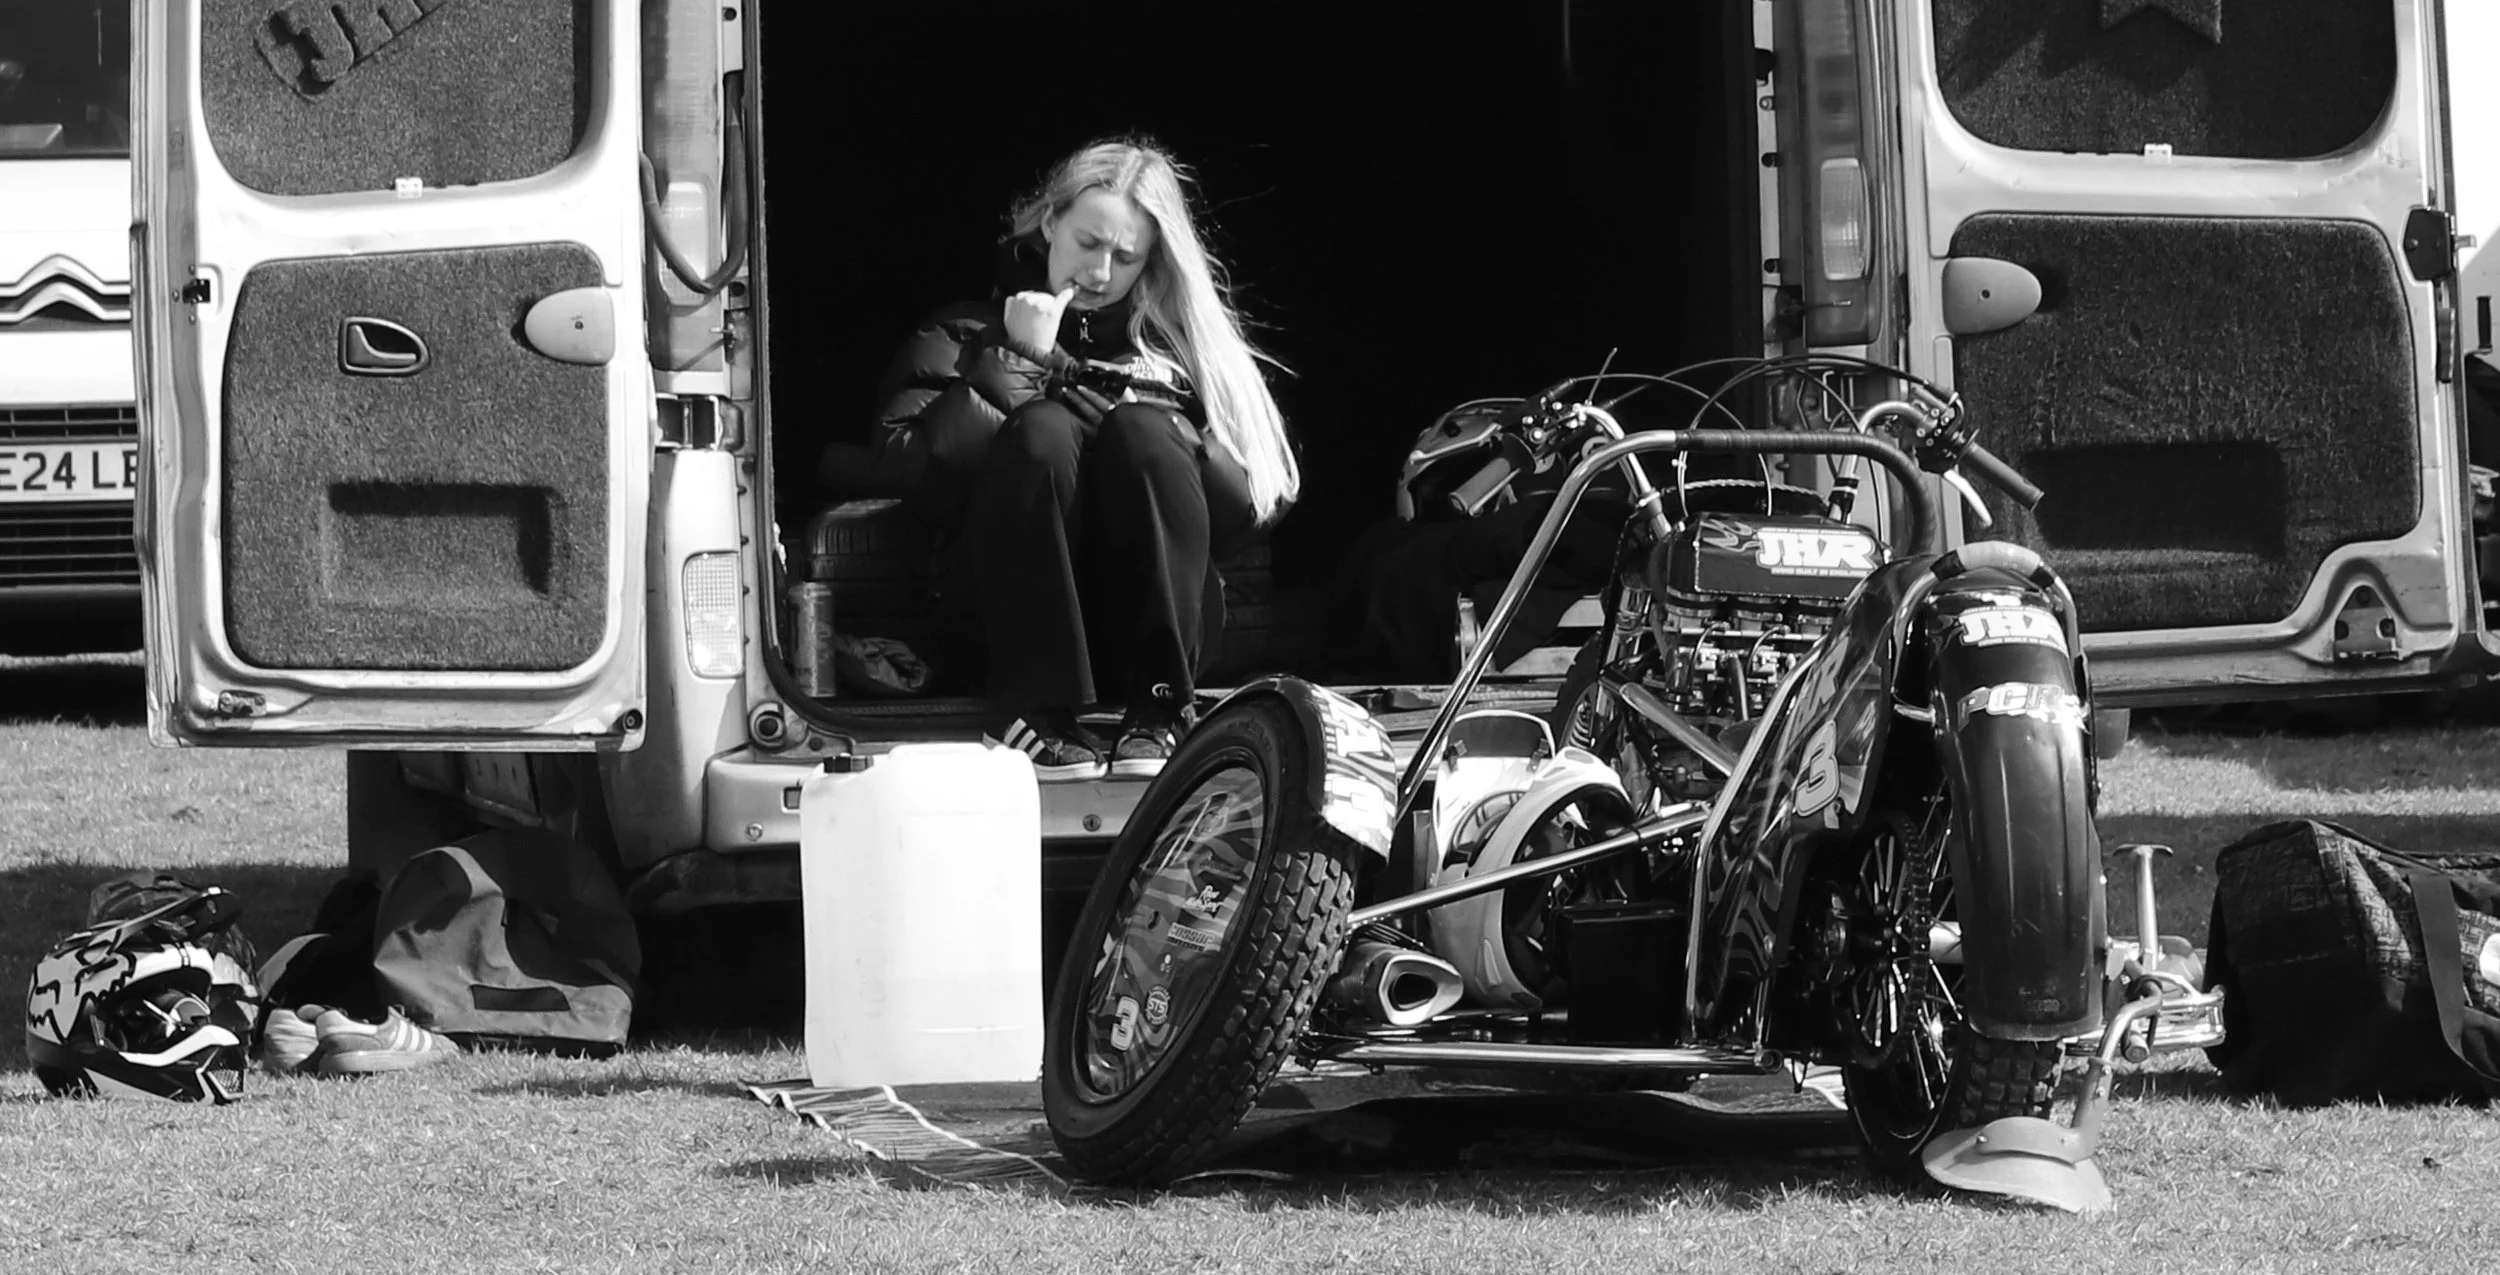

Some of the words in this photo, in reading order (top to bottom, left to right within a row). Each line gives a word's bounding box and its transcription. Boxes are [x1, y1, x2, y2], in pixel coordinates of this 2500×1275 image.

[1757, 530, 1877, 570] JHR
[1795, 719, 1841, 817] 3
[1110, 995, 1140, 1051] 3
[1147, 997, 1168, 1013] STS
